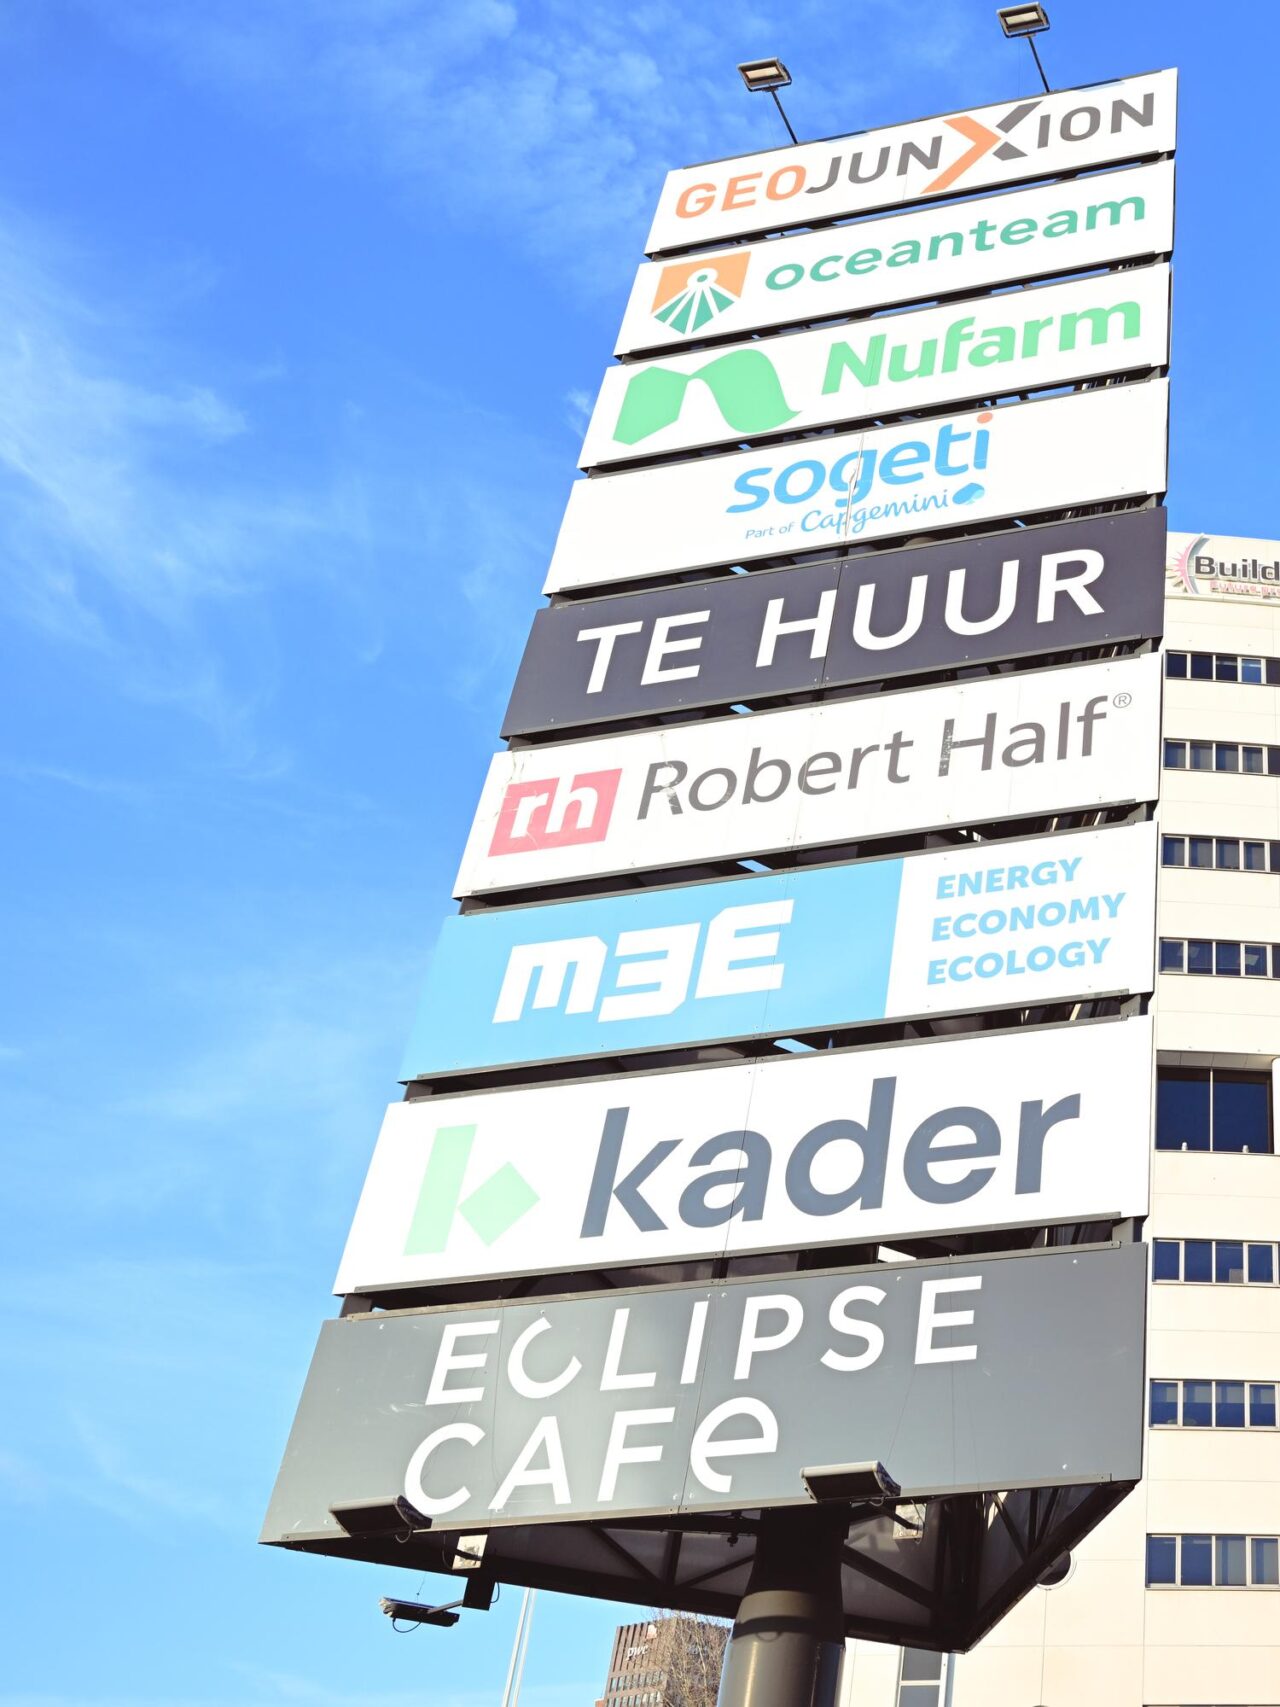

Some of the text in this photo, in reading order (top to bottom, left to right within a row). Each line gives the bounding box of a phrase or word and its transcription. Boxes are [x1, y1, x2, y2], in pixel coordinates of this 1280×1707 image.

[676, 93, 1154, 218] GEOJUNXION
[765, 196, 1145, 290] oceanteam
[821, 301, 1141, 395] Nufarm
[726, 412, 994, 513] sogeti
[745, 489, 949, 539] Part of Capgemini
[576, 548, 1105, 694] TE HUUR
[636, 730, 913, 821] Robert
[931, 892, 1127, 943] ECONOMY
[936, 857, 1083, 900] ENERGY
[926, 937, 1112, 986] ECOLOGY
[580, 1077, 1082, 1239] kader
[425, 1275, 983, 1406] ECLIPSE
[626, 1645, 649, 1661] pwc
